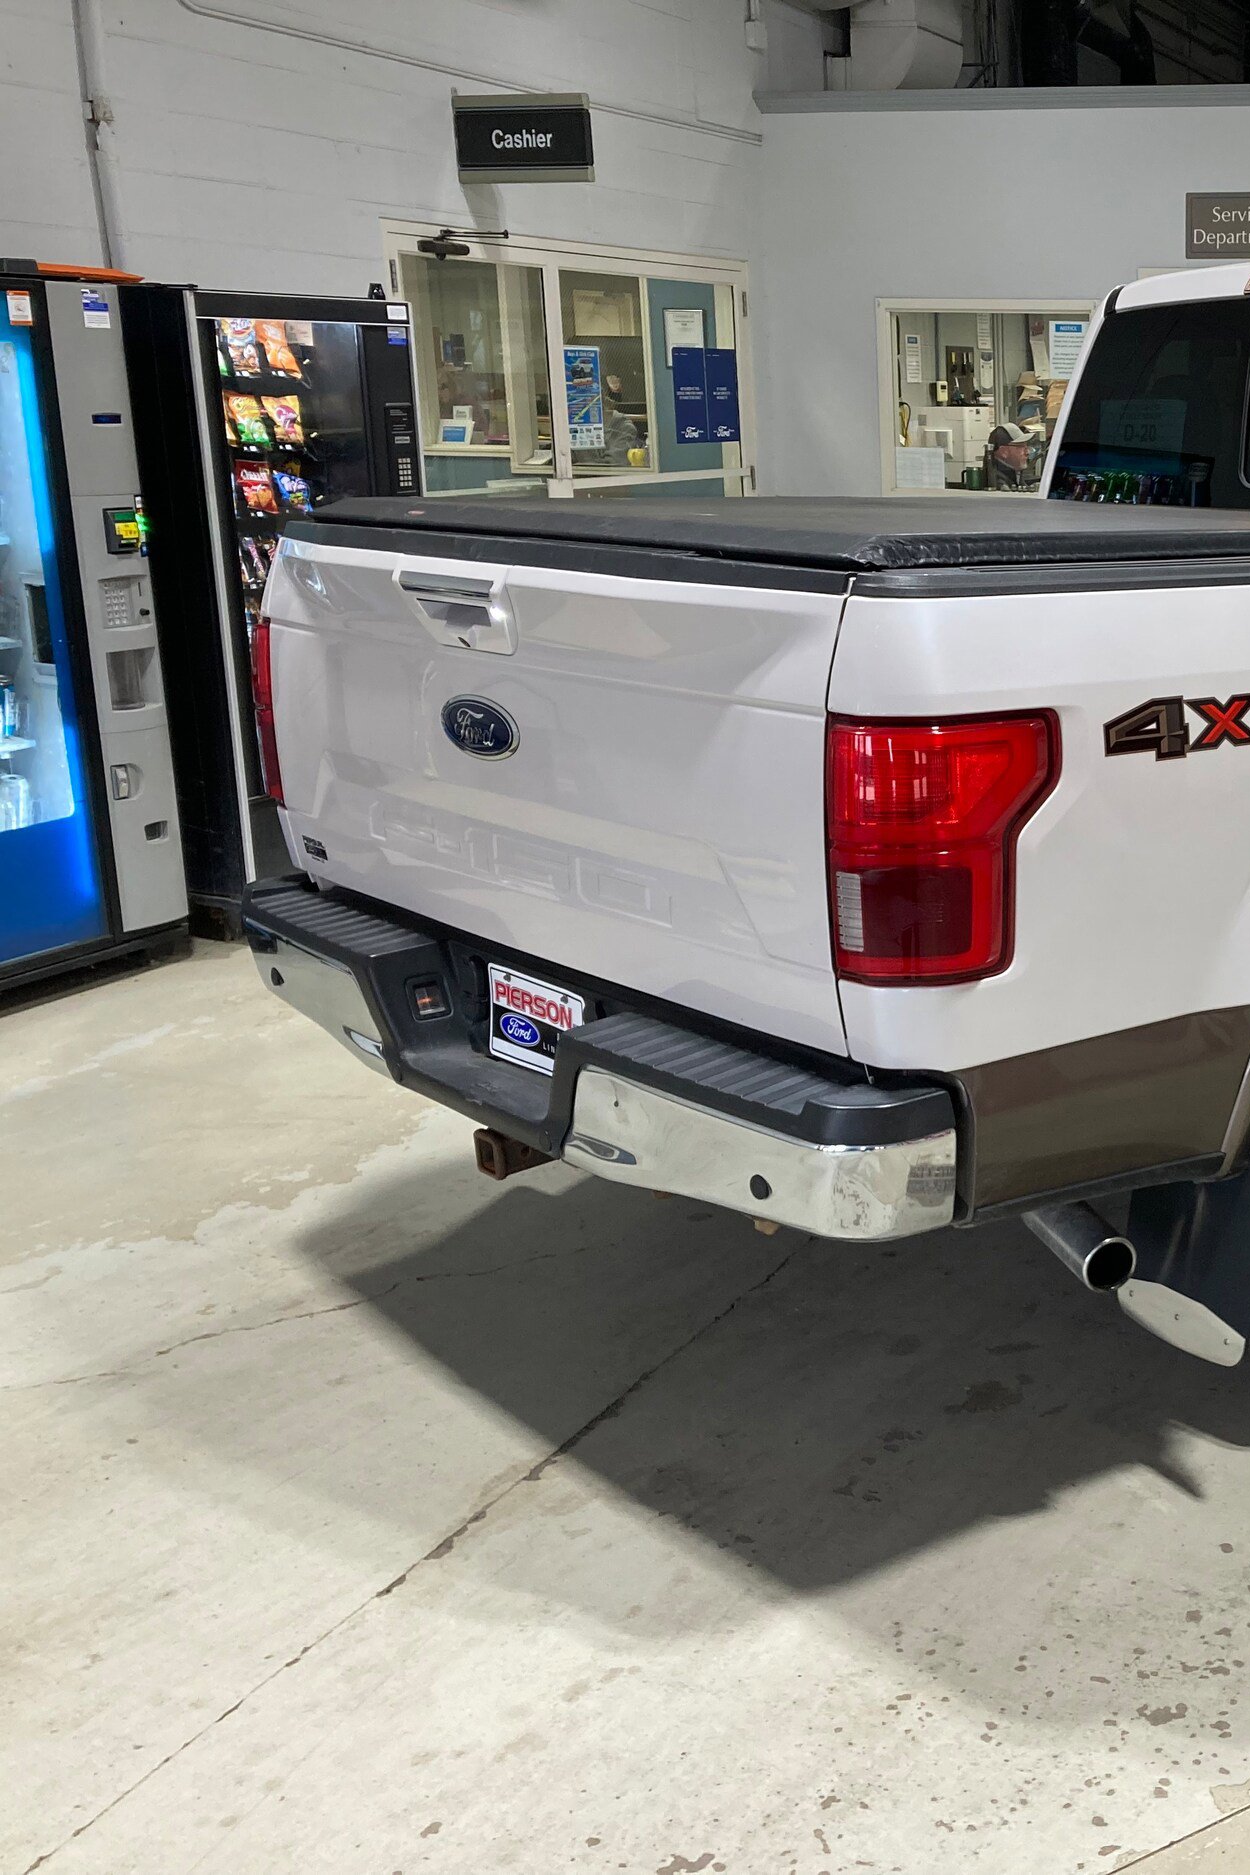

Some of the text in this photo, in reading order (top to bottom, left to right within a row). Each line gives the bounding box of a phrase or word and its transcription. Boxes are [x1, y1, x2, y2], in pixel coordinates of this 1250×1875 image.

[491, 129, 553, 149] Cashier
[454, 707, 496, 746] Ford
[495, 979, 573, 1030] PIERSON
[508, 1017, 532, 1041] Ford
[543, 1041, 556, 1054] LIN
